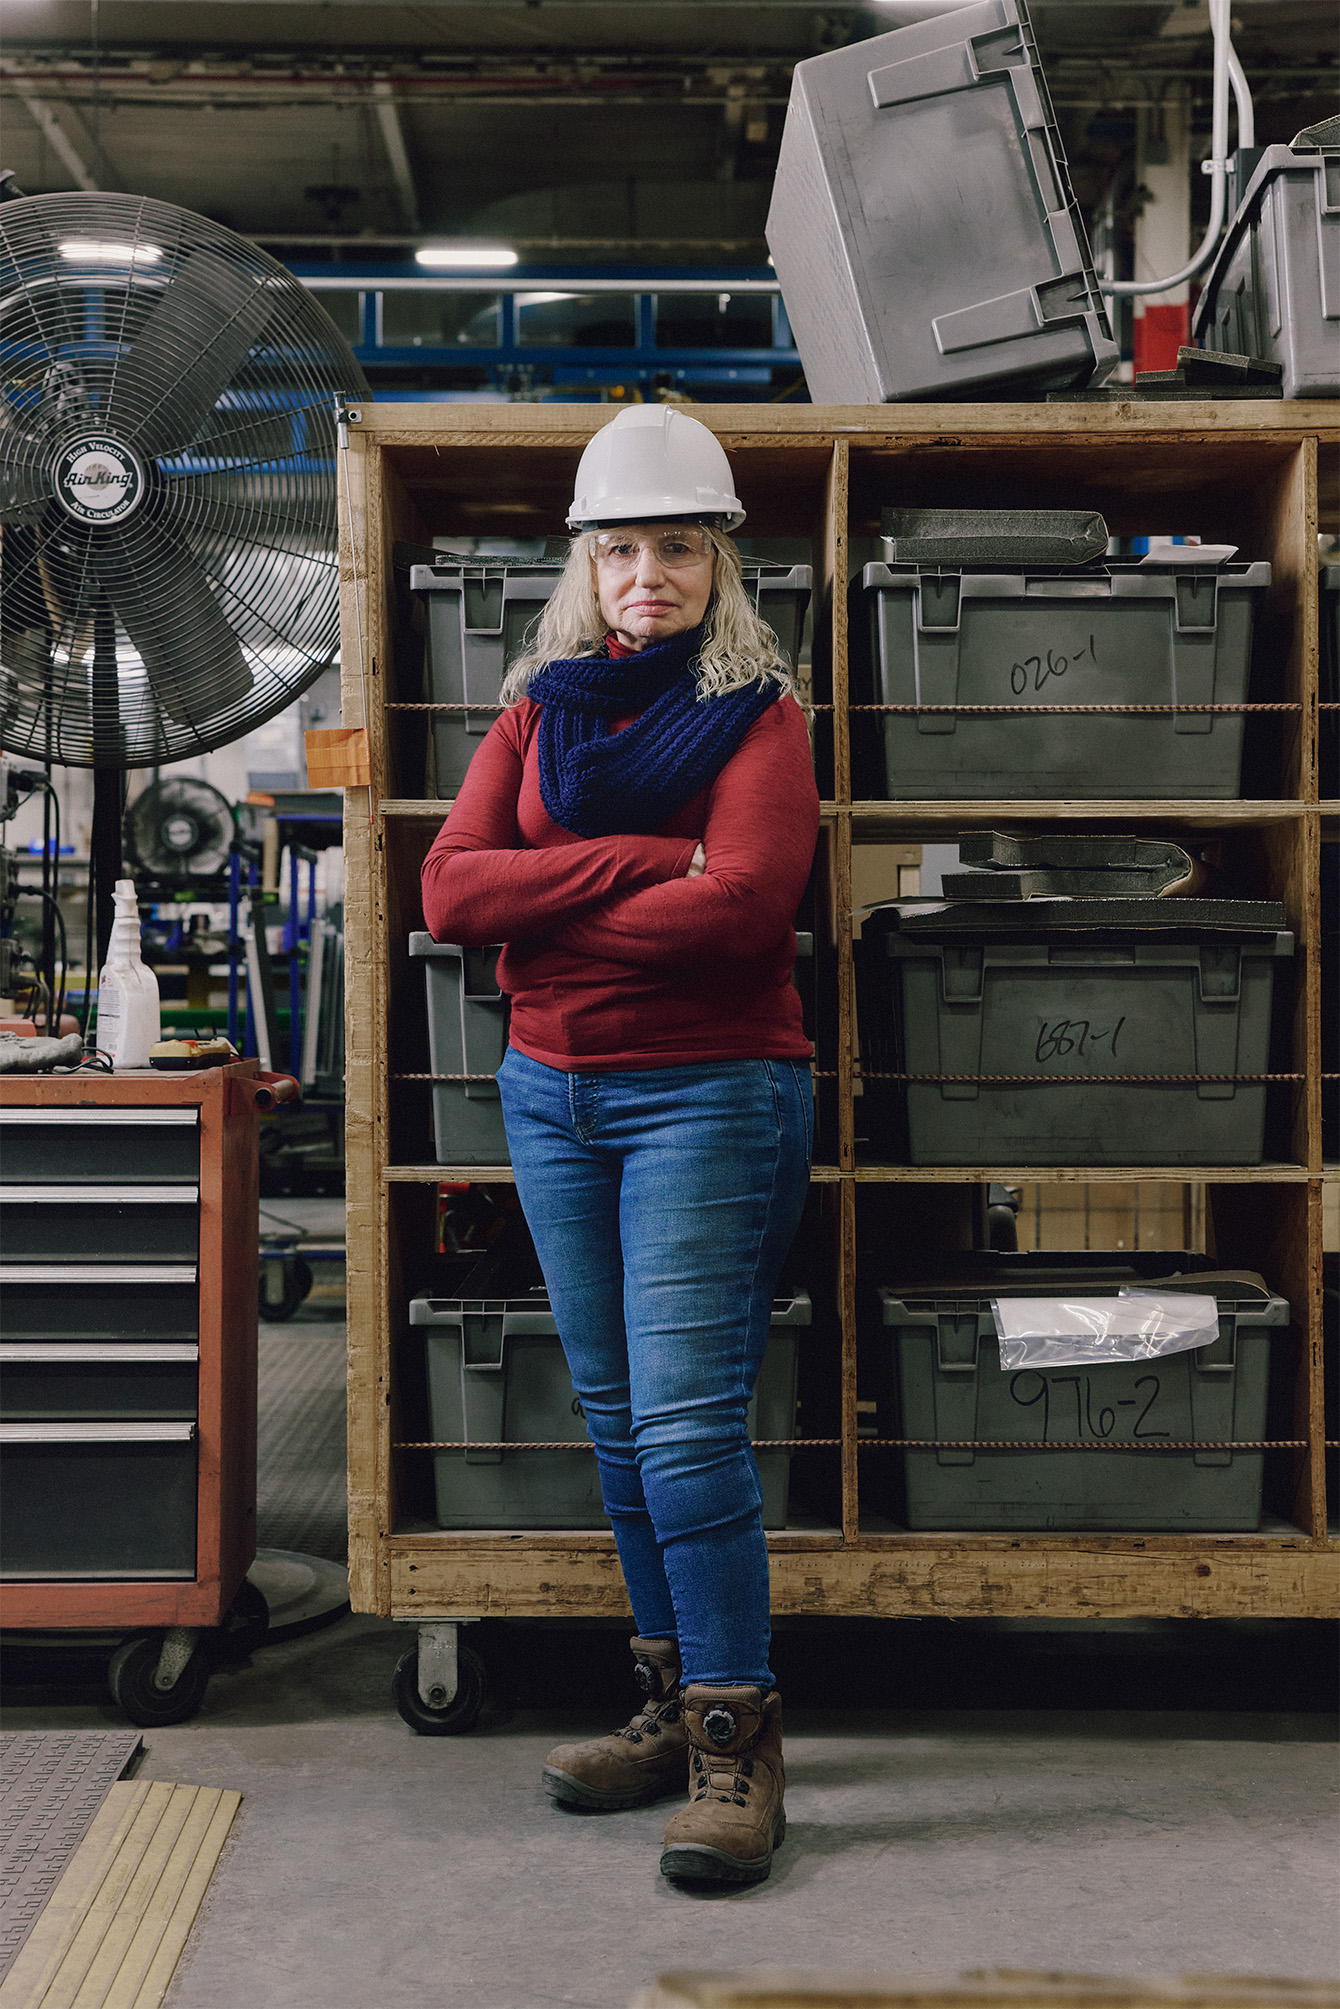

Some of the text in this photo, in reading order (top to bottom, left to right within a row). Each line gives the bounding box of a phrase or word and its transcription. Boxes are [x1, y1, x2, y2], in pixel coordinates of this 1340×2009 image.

[66, 442, 125, 463] HIGH VELOCITY
[71, 500, 130, 518] AIR CIRCULATOR
[1010, 634, 1098, 695] 026-1
[1035, 1016, 1126, 1063] 687-1
[1009, 1370, 1170, 1442] 976-2
